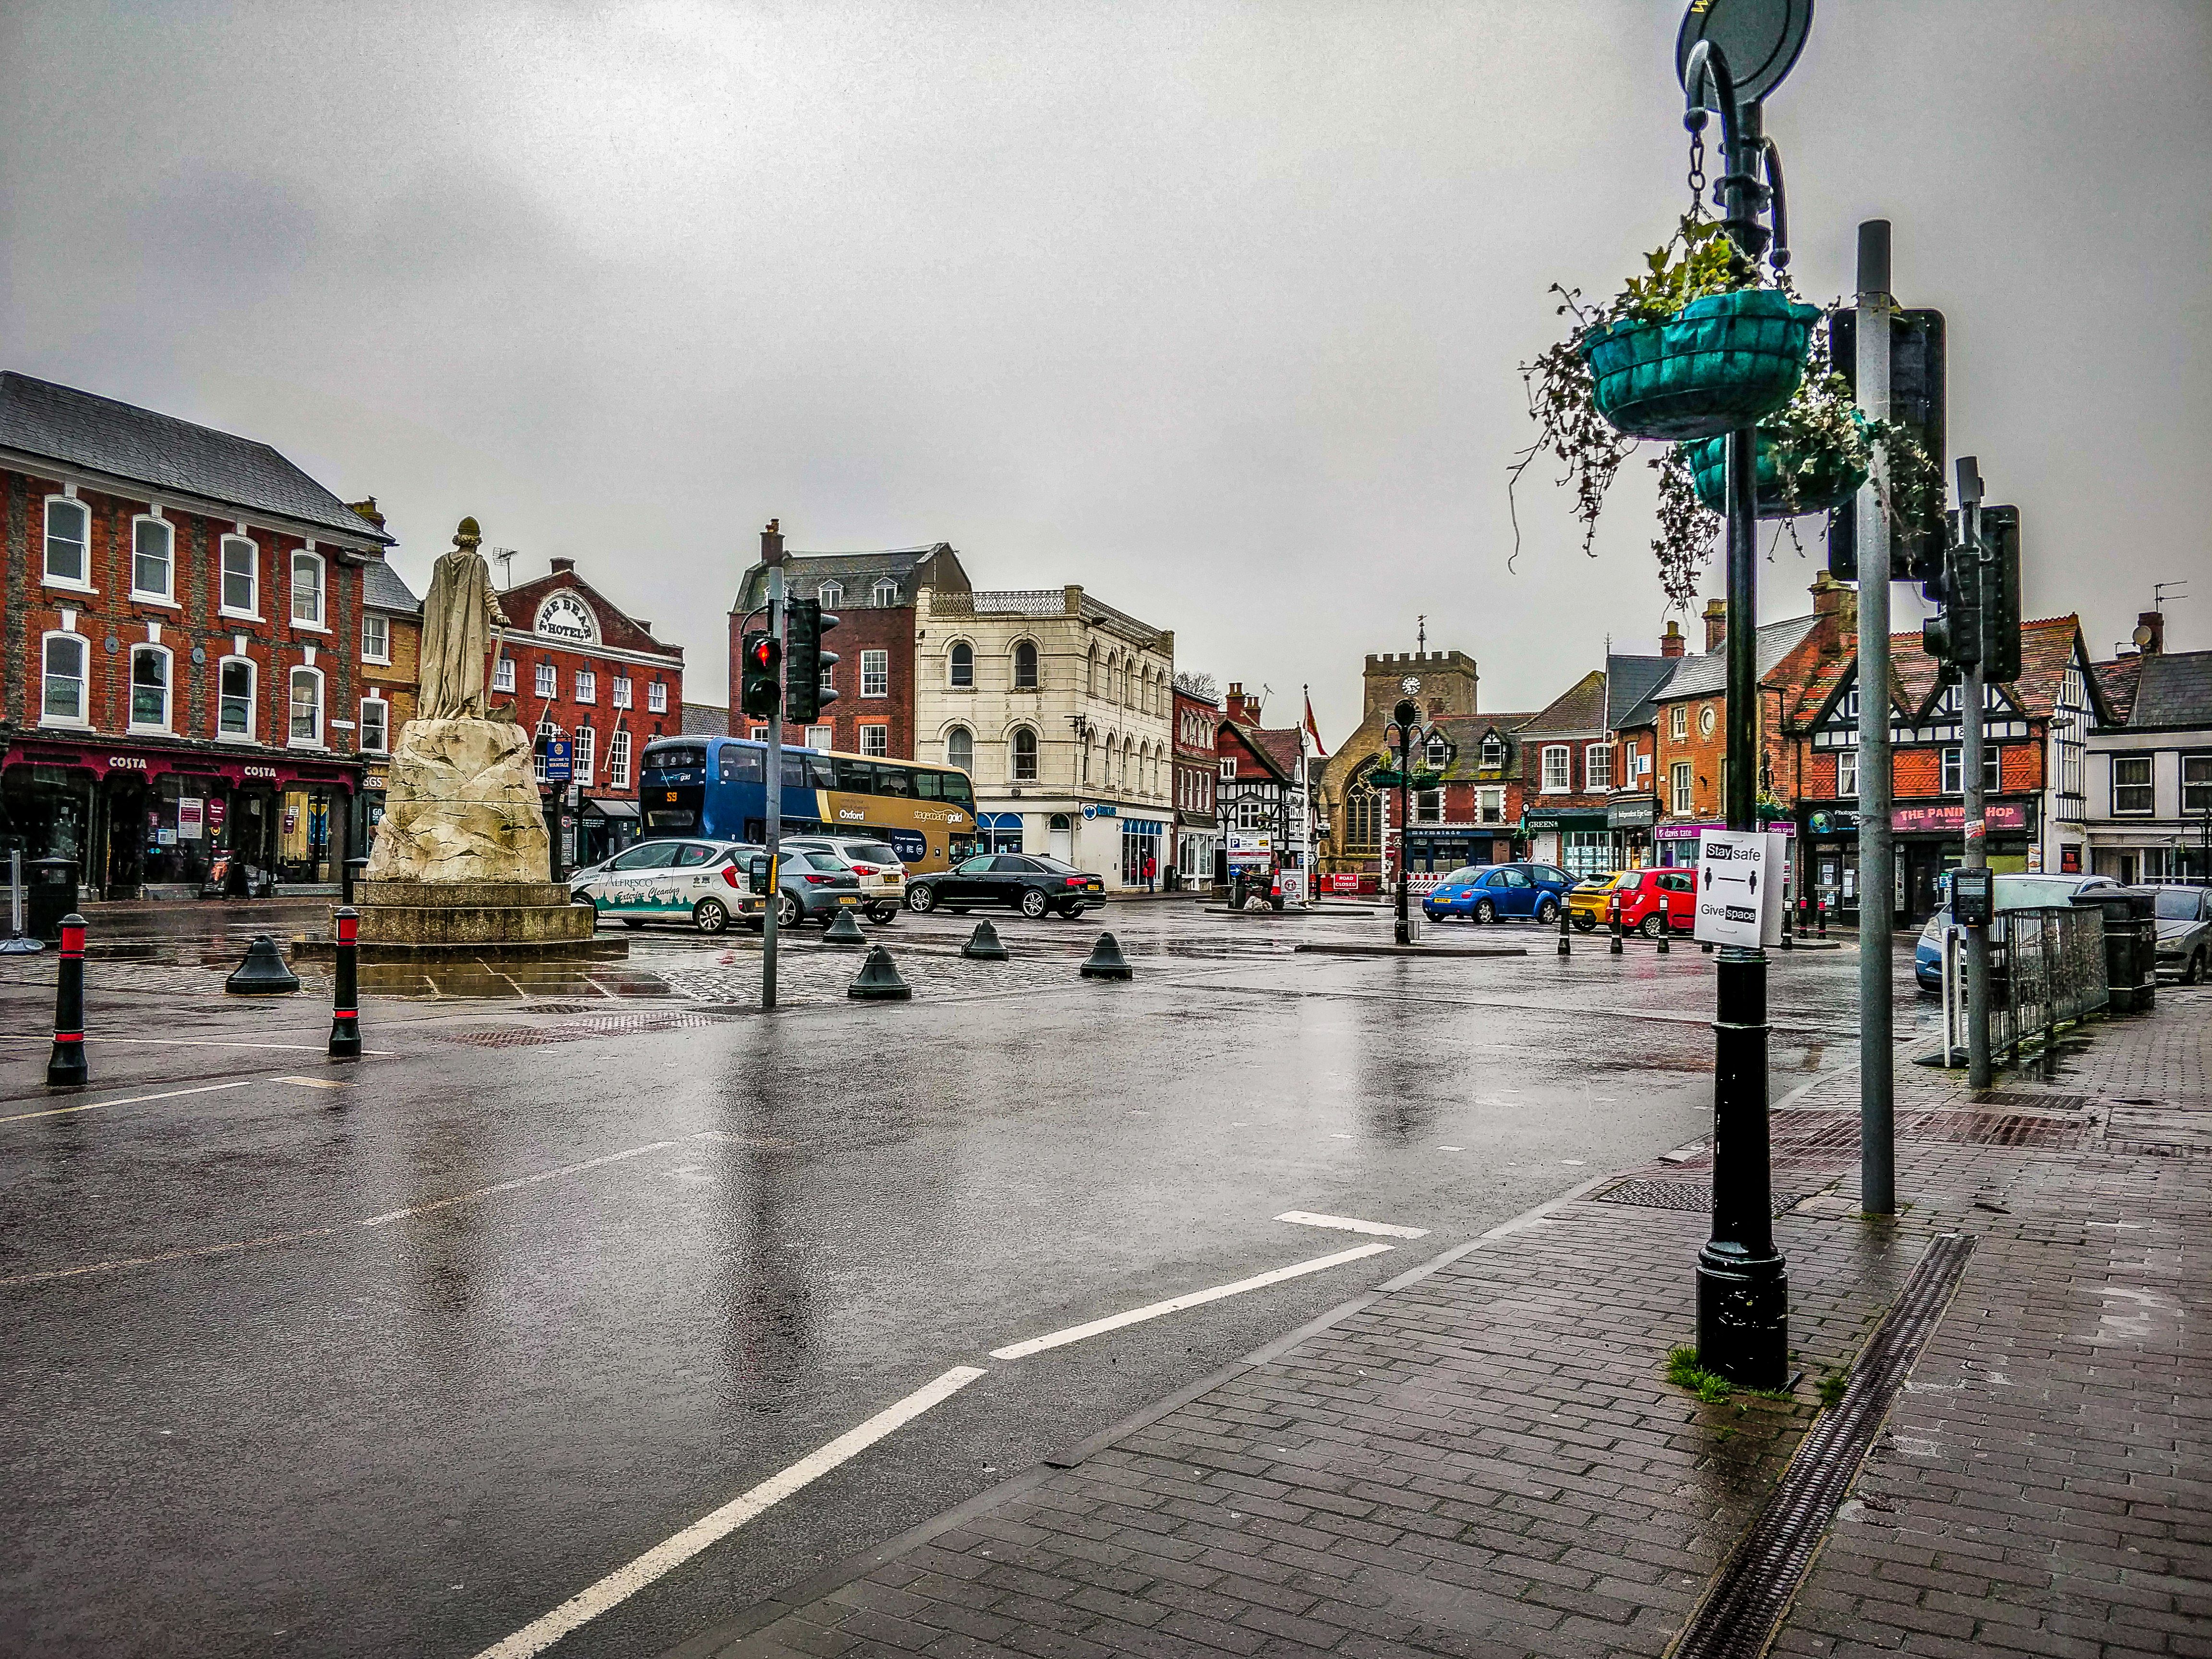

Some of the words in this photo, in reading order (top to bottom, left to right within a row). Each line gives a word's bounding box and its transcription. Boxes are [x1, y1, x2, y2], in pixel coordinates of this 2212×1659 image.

[539, 600, 560, 631] THE
[563, 599, 592, 639] BEAR
[547, 623, 584, 639] HOTEL
[109, 757, 147, 769] COSTA
[244, 766, 276, 777] COSTA
[362, 776, 383, 788] GGS
[666, 792, 677, 802] S9
[839, 809, 865, 821] Oxford
[913, 810, 947, 822] stagecoach
[947, 812, 963, 824] gold
[1900, 810, 1925, 821] THE
[1927, 806, 1966, 818] PANIN
[1985, 807, 2014, 817] HOP
[1707, 844, 1732, 859] Stay
[1733, 848, 1761, 862] safe
[605, 876, 653, 887] ALFRESCO
[648, 886, 680, 899] Cleaning
[1701, 903, 1725, 916] Give
[1726, 909, 1755, 920] space
